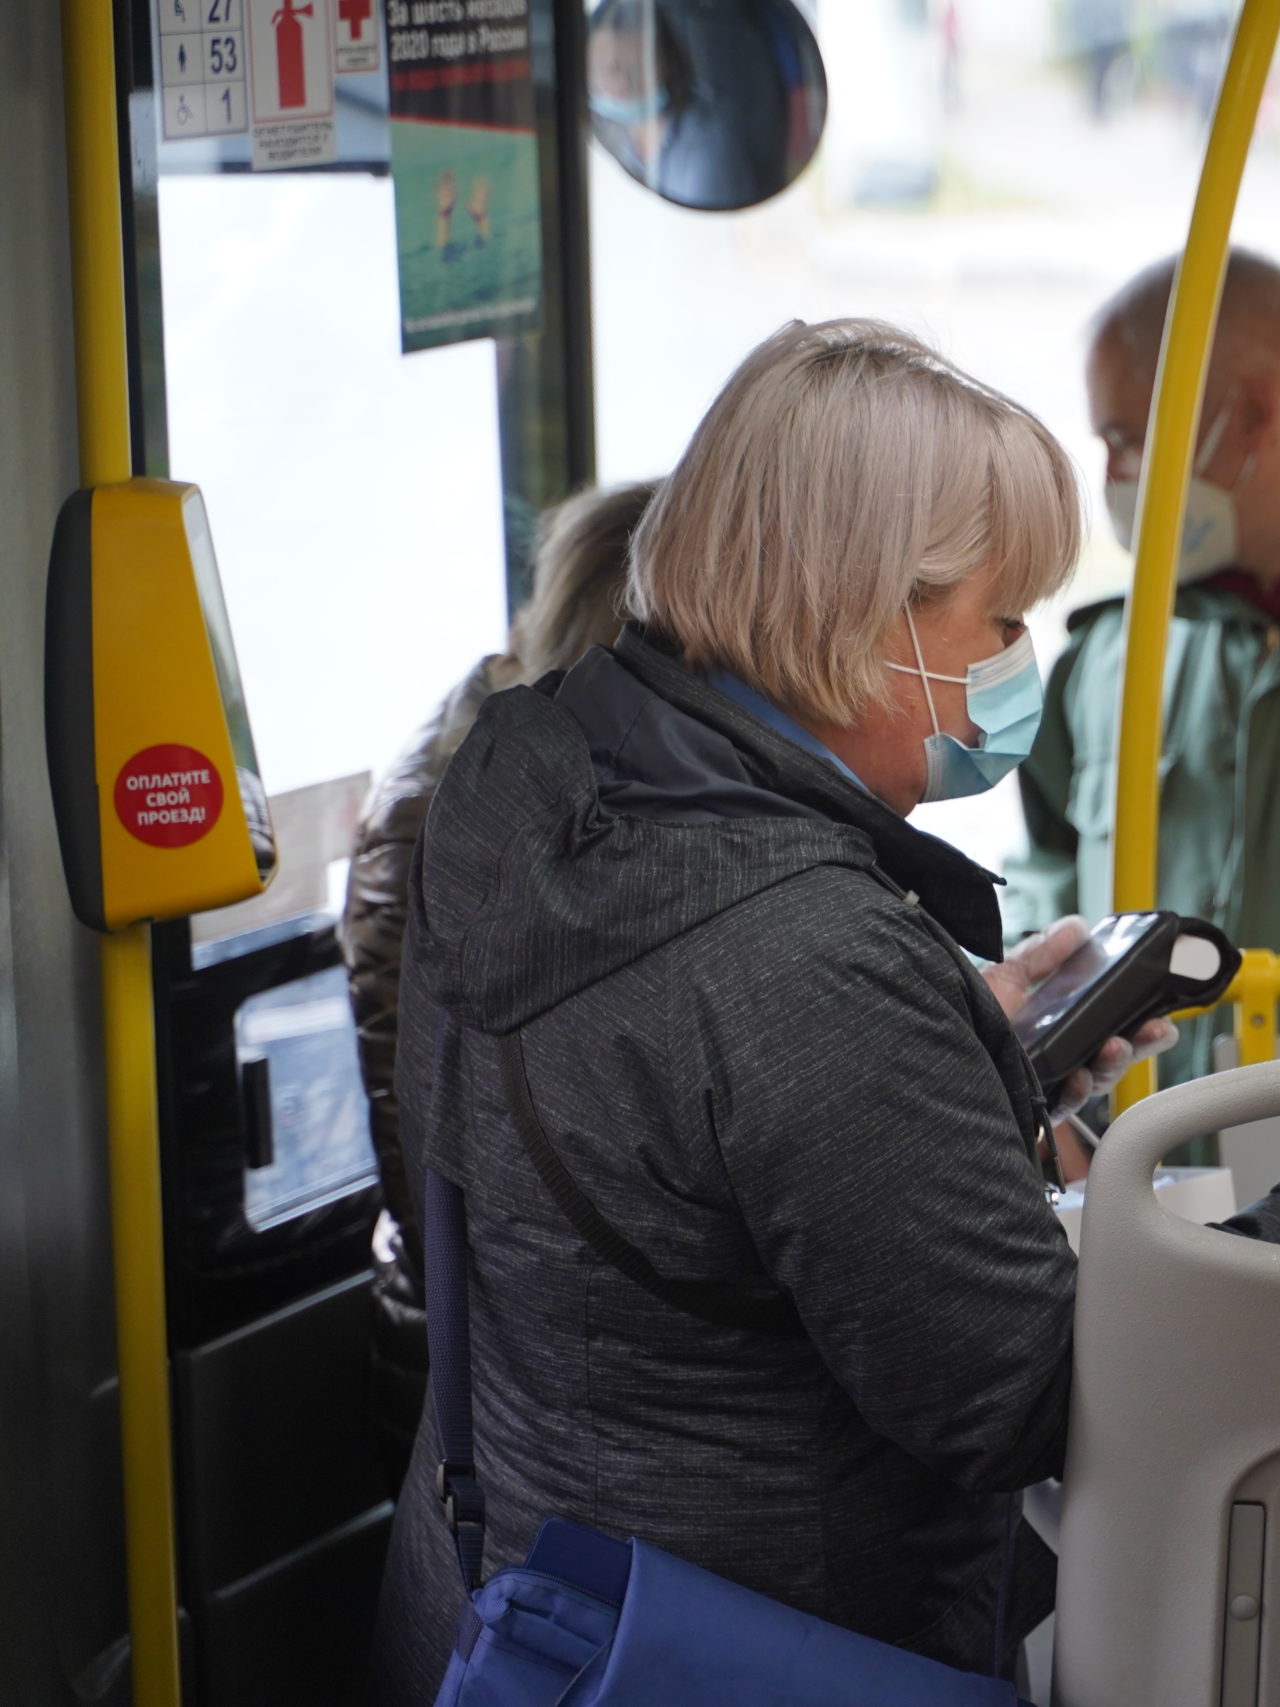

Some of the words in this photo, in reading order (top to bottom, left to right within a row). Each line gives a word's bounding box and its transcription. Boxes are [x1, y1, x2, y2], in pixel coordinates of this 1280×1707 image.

[210, 37, 237, 73] 53
[222, 87, 232, 124] 1
[126, 769, 210, 791] ОПЛАТИТЕ
[146, 787, 190, 807] СВОЙ
[137, 807, 206, 825] ПРОЕЗД!
